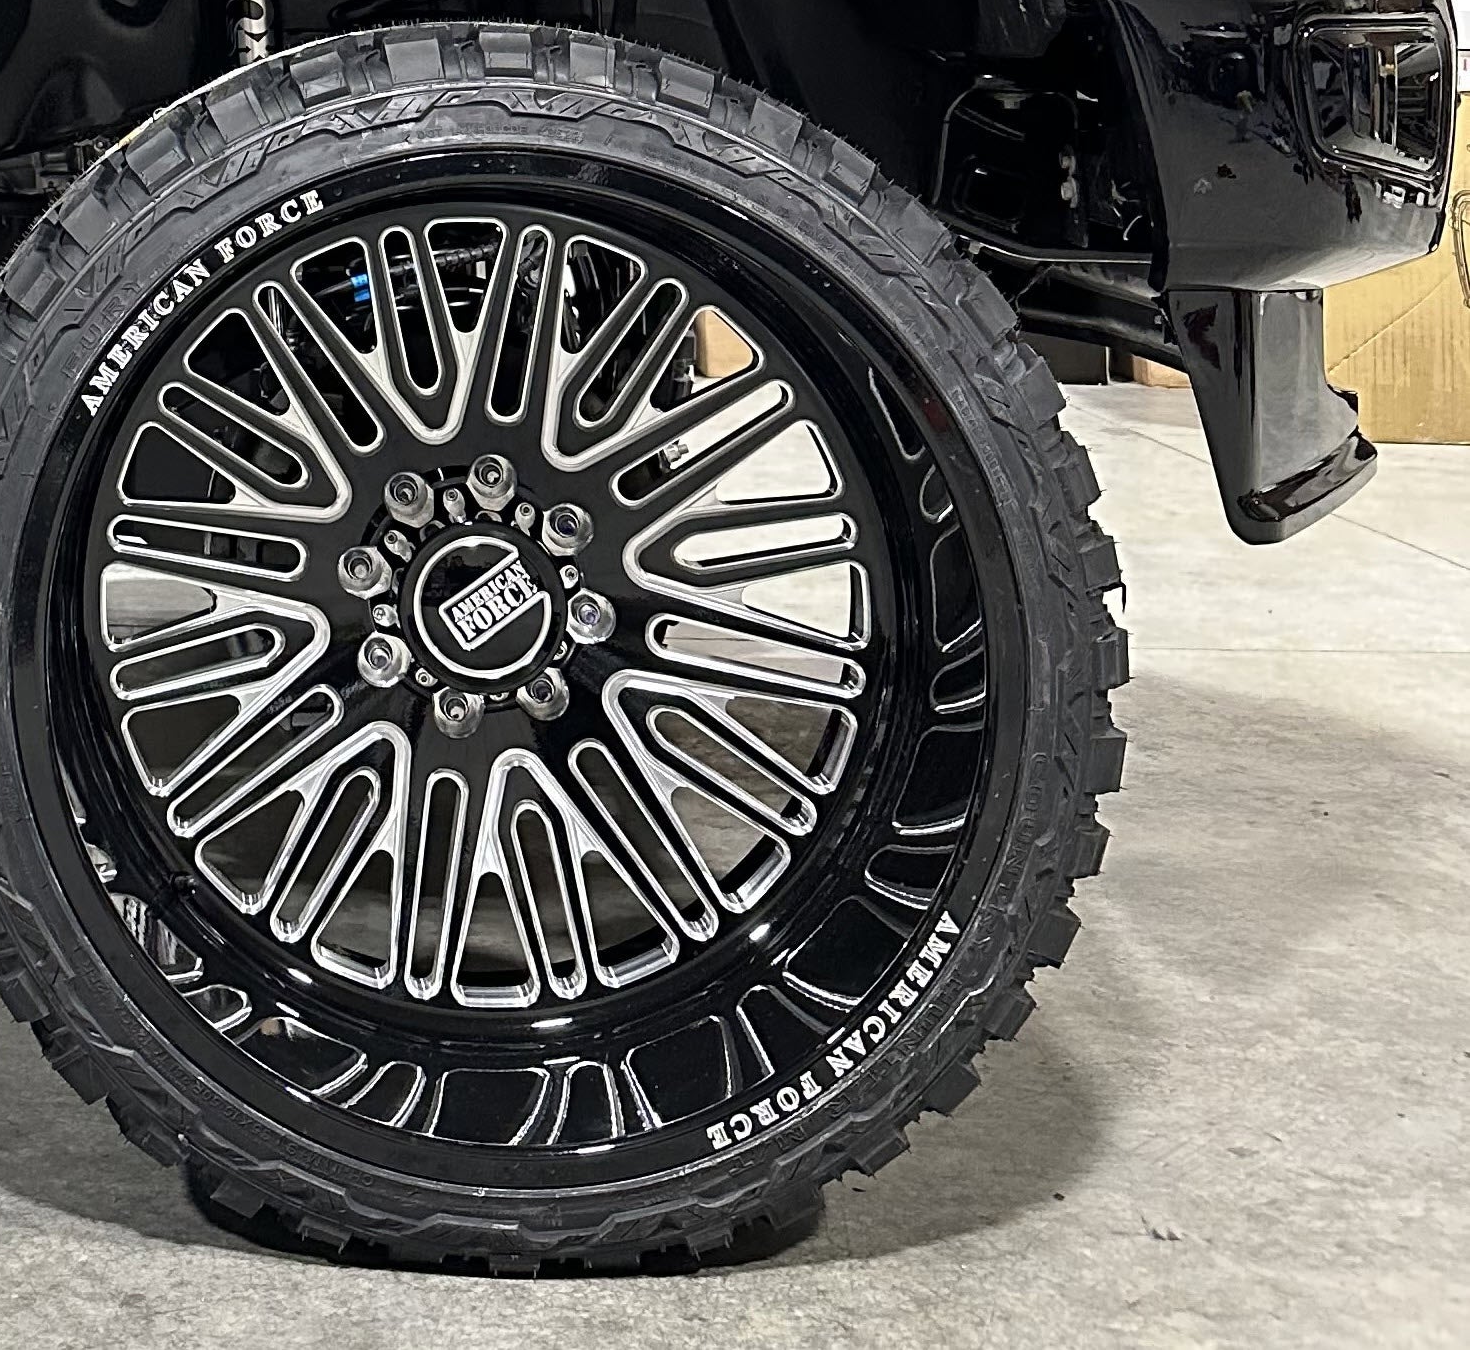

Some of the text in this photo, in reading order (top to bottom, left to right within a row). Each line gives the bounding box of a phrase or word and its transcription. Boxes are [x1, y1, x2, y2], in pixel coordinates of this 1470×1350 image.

[81, 189, 324, 416] AMERICAN FORCE
[451, 559, 531, 623] AMERICAN
[456, 576, 538, 641] FORCE
[706, 910, 961, 1150] AMERICAN FORCE
